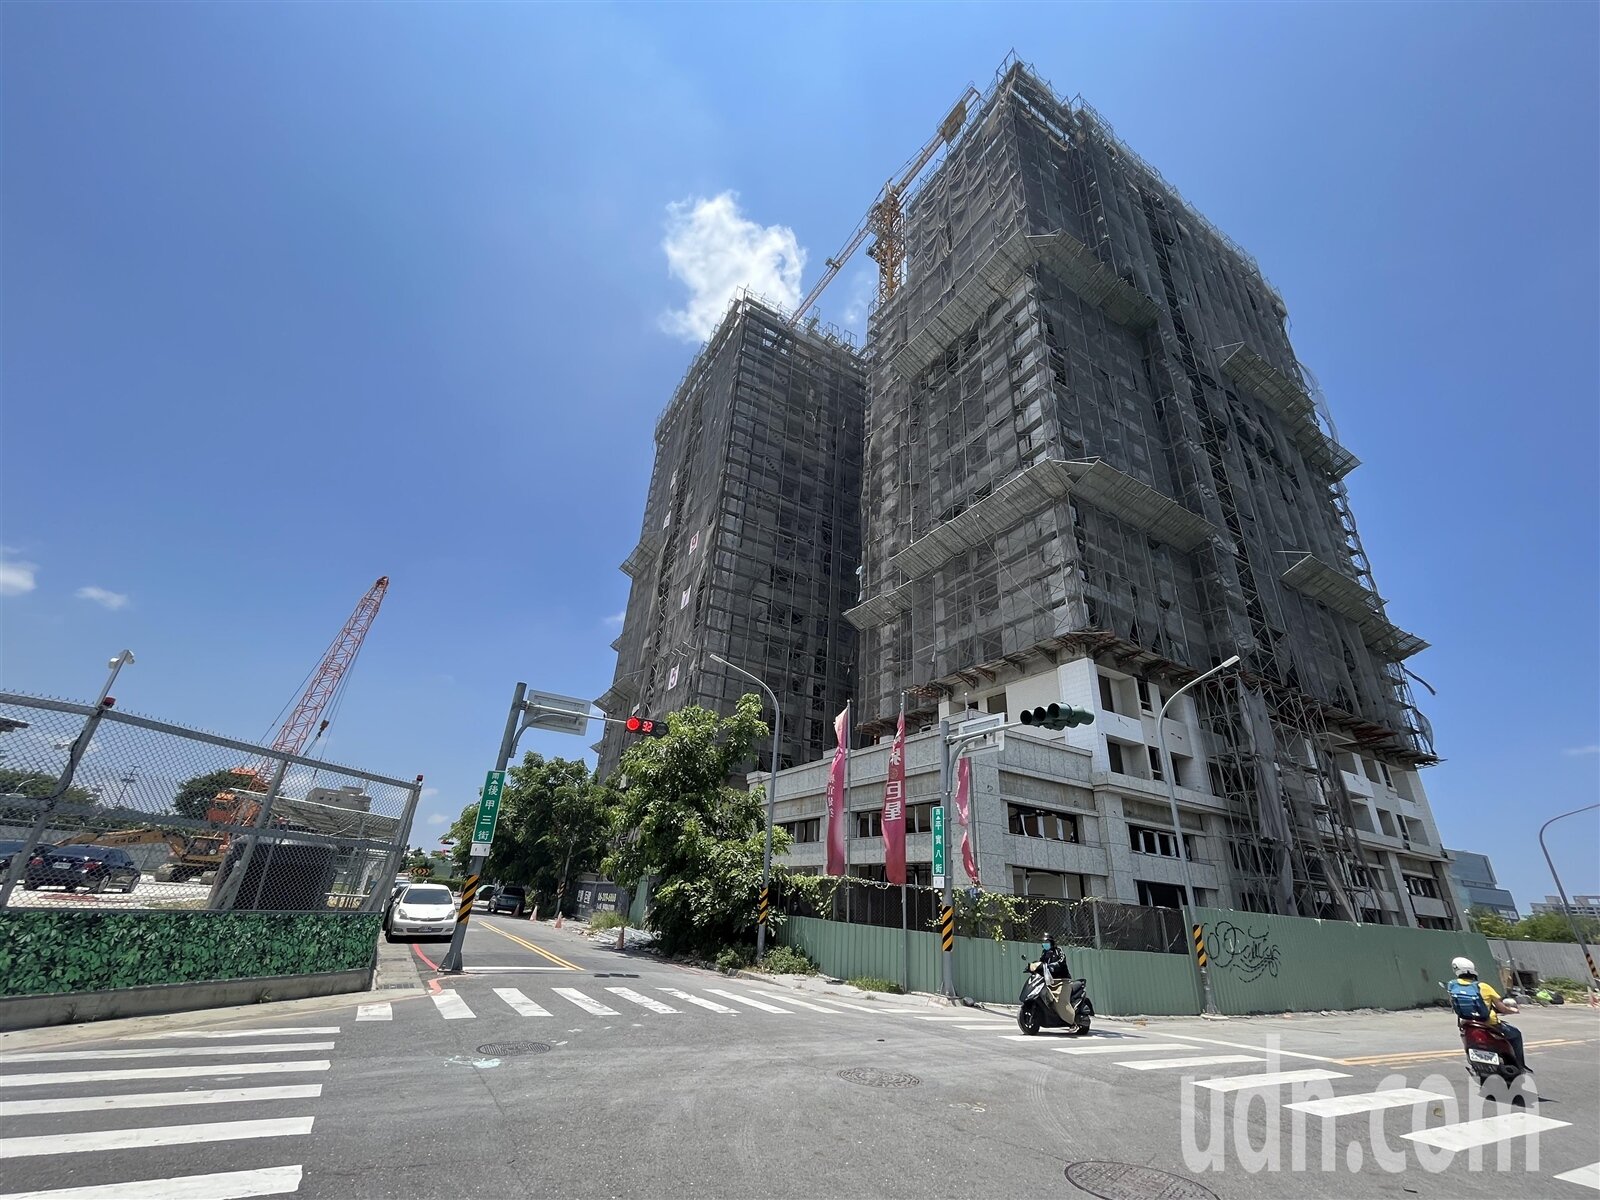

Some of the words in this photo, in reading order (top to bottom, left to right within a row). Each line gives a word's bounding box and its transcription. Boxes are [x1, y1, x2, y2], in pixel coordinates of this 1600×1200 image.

[478, 785, 498, 840] 後甲三街
[127, 835, 142, 843] CAT
